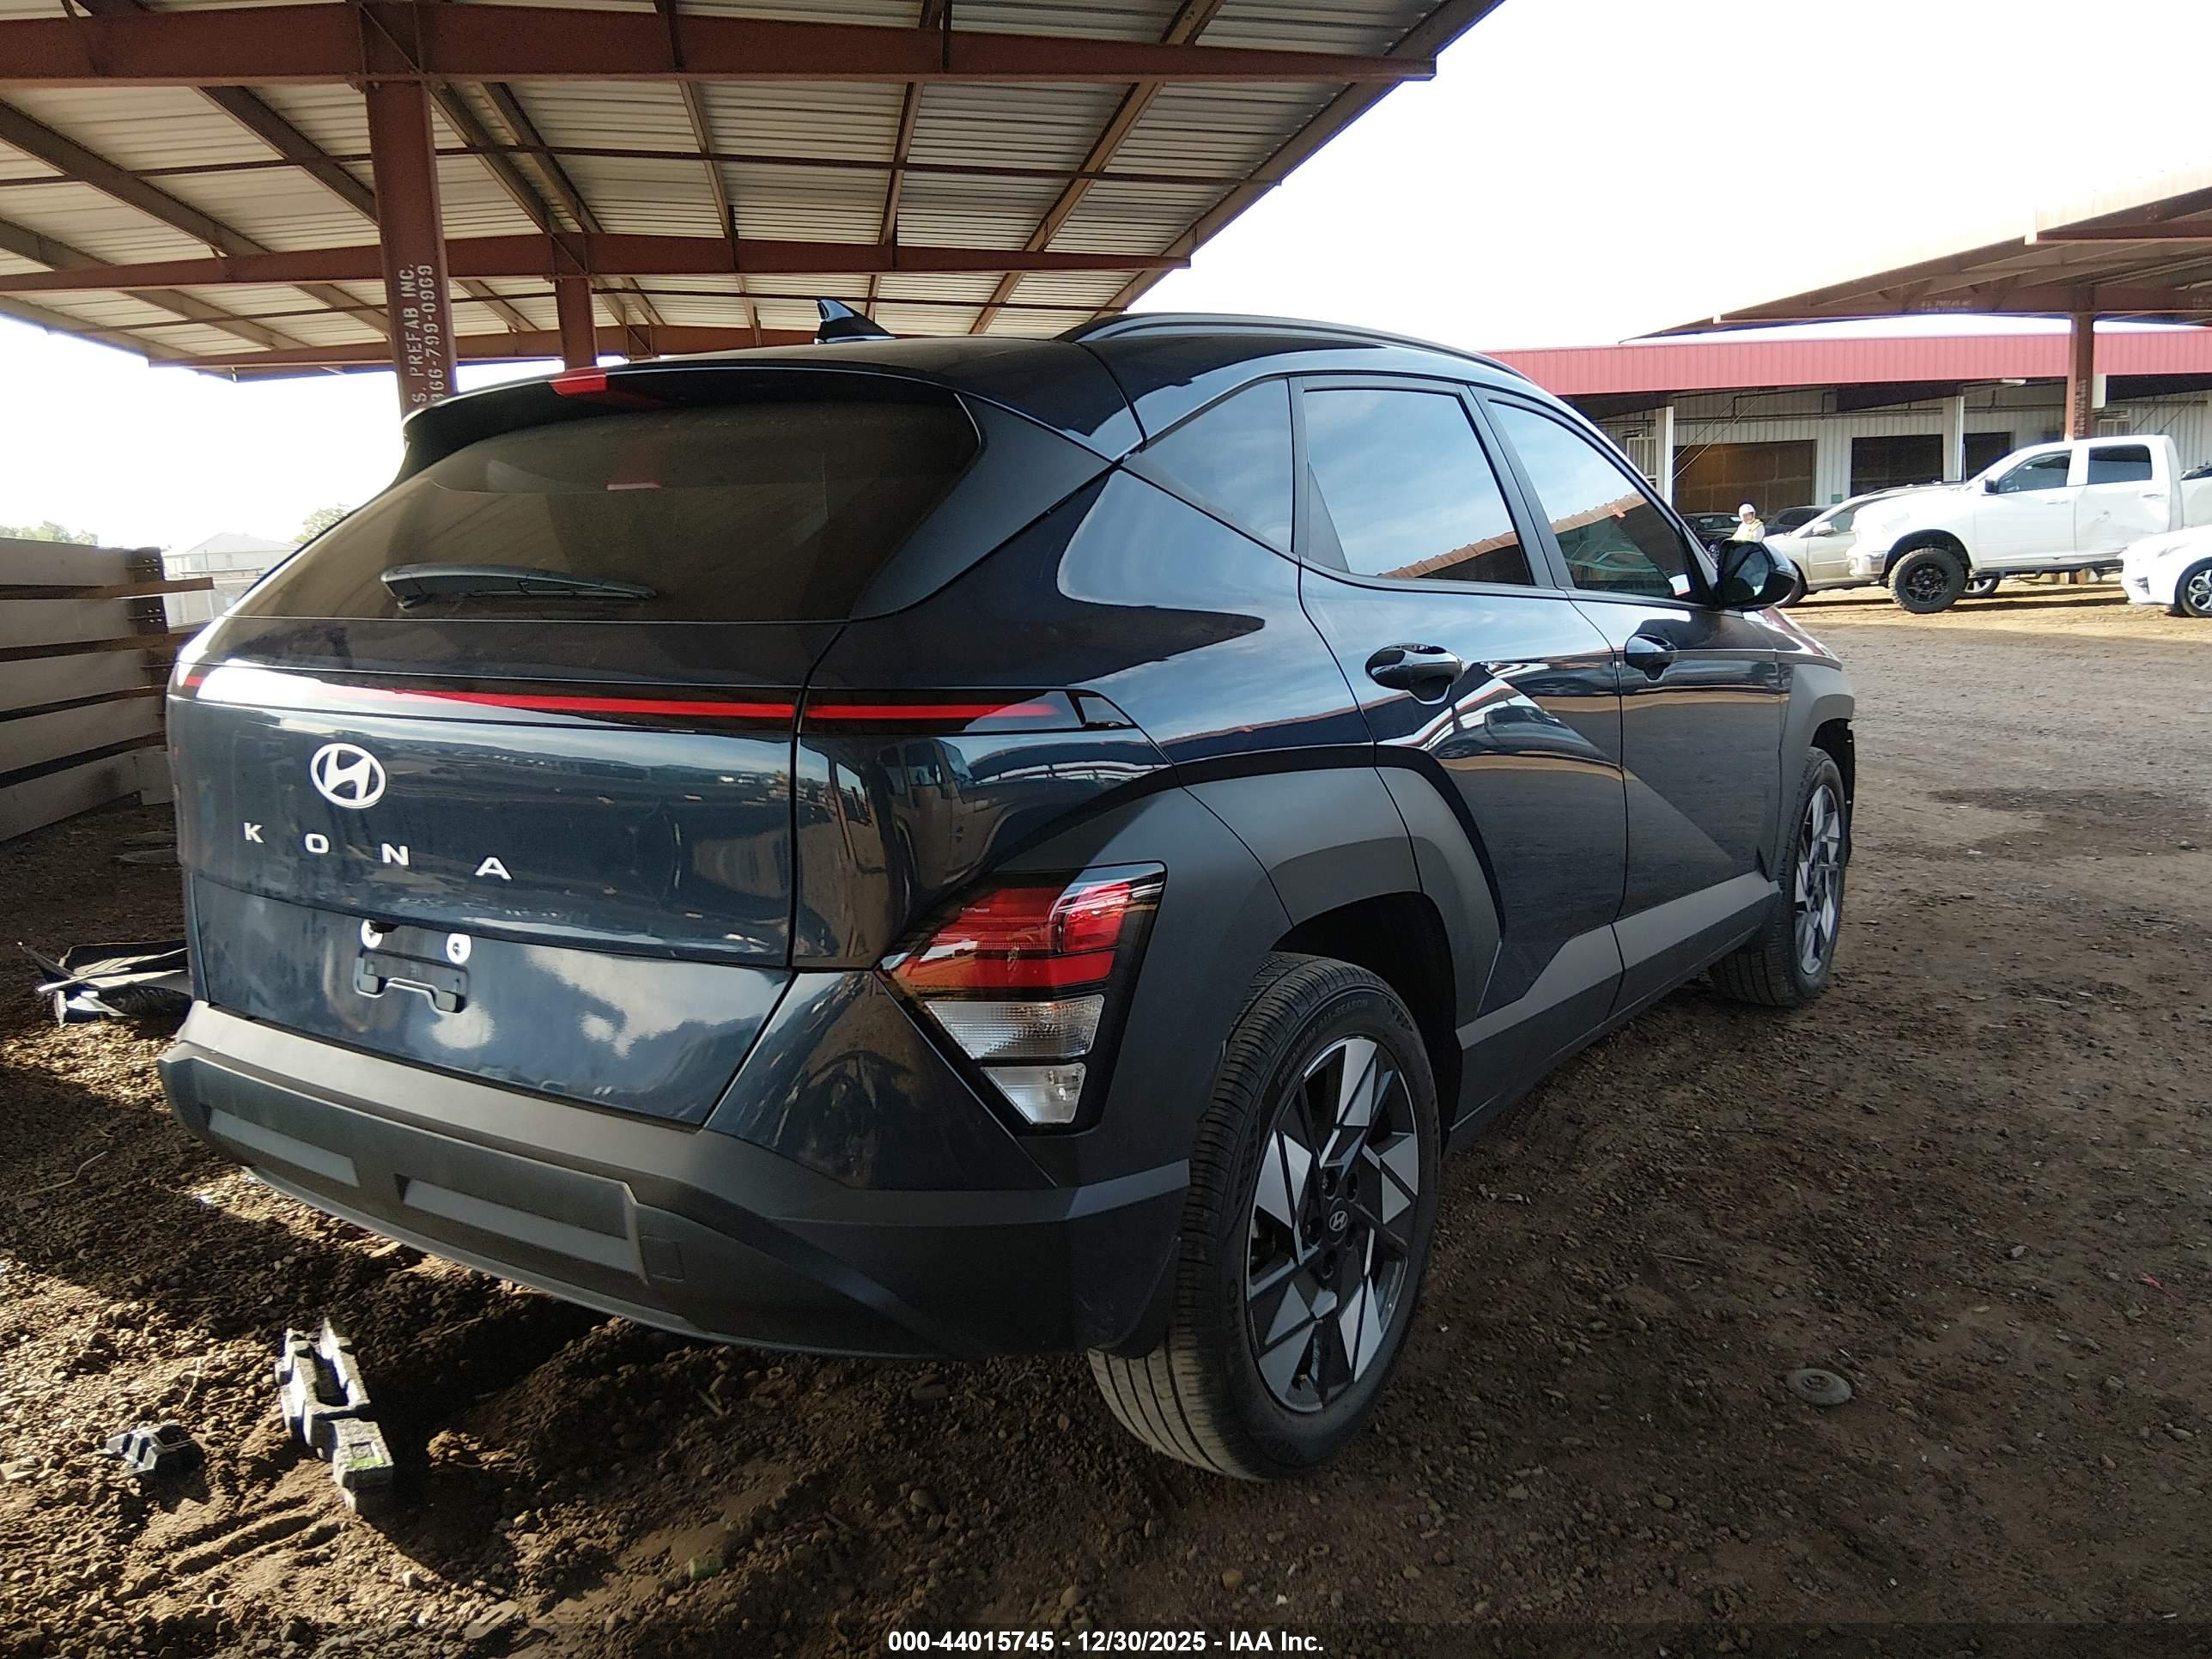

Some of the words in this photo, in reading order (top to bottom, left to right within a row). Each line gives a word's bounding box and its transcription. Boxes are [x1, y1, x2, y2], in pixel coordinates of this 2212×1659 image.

[398, 263, 417, 298] INC.
[402, 307, 426, 377] PREFAB
[243, 821, 513, 881] KONA
